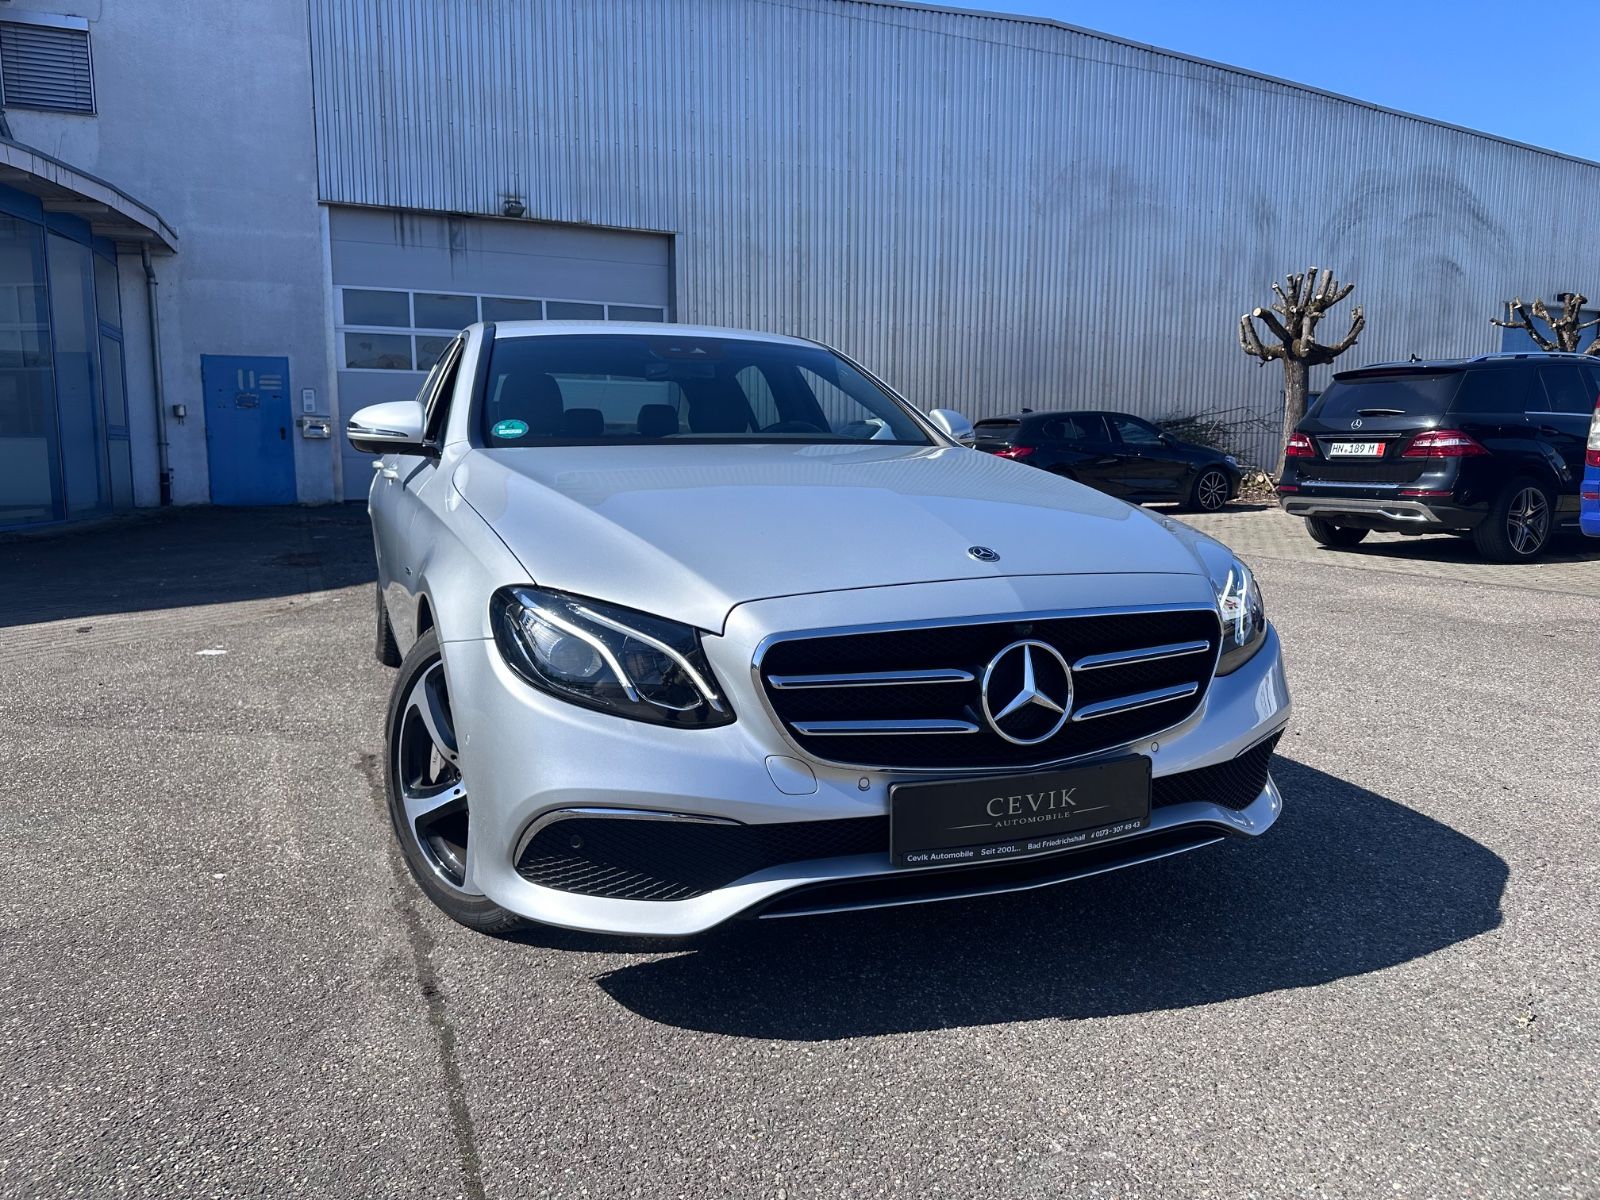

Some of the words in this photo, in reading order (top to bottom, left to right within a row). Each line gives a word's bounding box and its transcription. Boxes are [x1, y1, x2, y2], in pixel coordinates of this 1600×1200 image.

[1332, 444, 1344, 453] HN
[1349, 444, 1365, 453] 189
[1368, 444, 1375, 453] M
[986, 787, 1077, 817] CEVIK
[995, 811, 1070, 828] AUTOMOBILE
[907, 854, 928, 862] Cevik
[930, 850, 974, 861] Automobile
[981, 848, 995, 856] Seit
[1042, 833, 1086, 848] Friedrichshall
